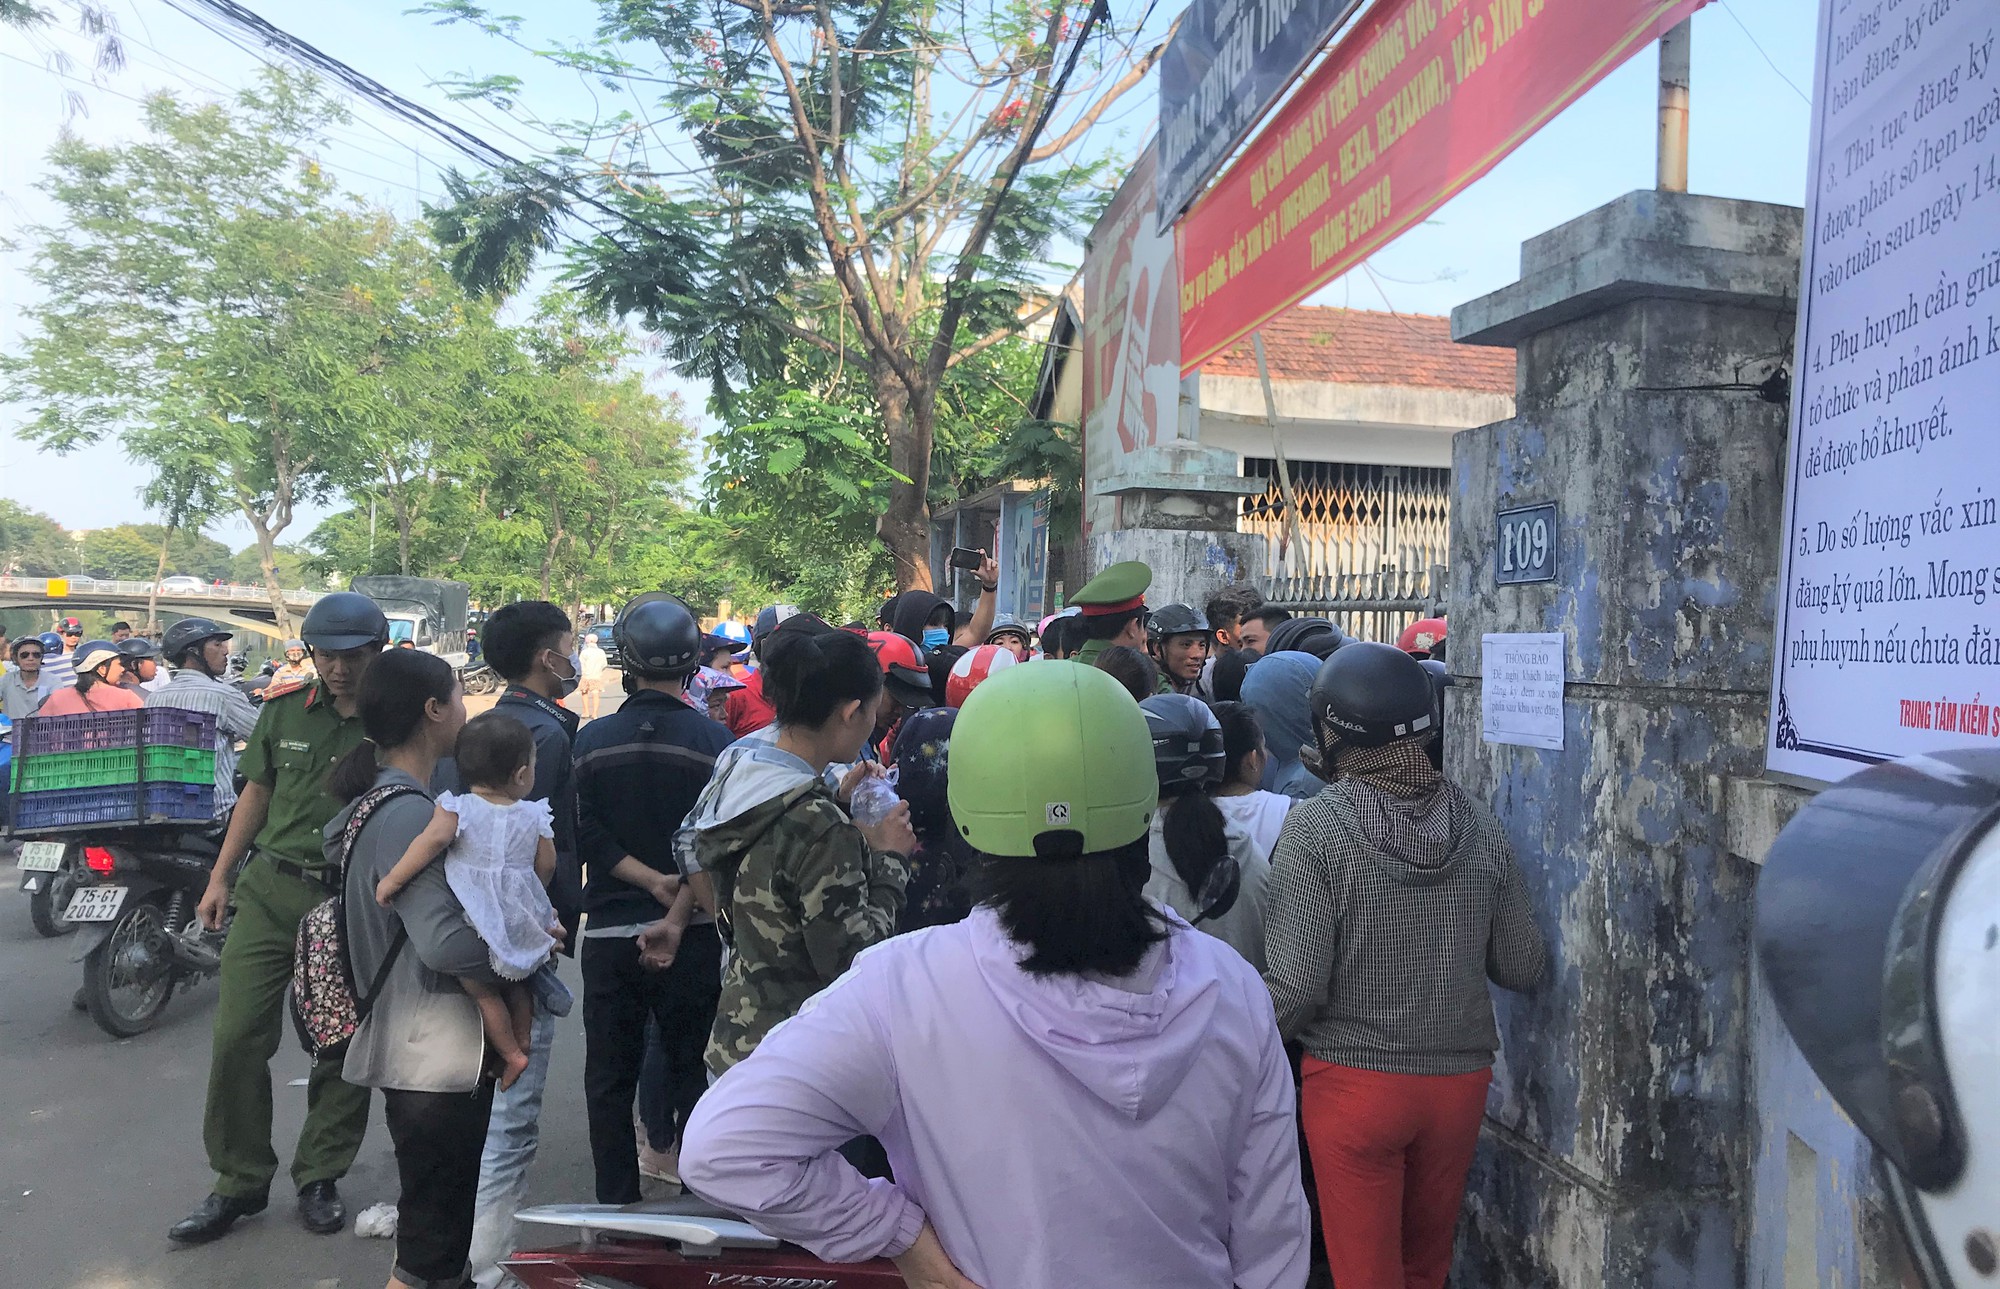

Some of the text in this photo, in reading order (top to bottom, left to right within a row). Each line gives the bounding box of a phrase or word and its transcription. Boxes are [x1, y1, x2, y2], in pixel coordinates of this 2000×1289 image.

[1451, 6, 1487, 85] VẮC
[1832, 77, 1859, 115] bản
[1861, 35, 1901, 89] đăng
[1902, 3, 1926, 51] ký
[1826, 28, 1995, 193] 3. Thủ tục đăng ký
[1822, 87, 2000, 245] được phát số hẹn ngà
[1310, 174, 1391, 271] THÁNG 5/2019
[1818, 262, 1843, 297] vào
[1845, 231, 1882, 280] tuần
[1885, 215, 1916, 256] sau
[1917, 184, 1968, 237] ngày
[1813, 344, 1825, 374] 4.
[1828, 329, 1860, 367] Phụ
[1862, 293, 1919, 347] huynh
[1924, 270, 1960, 320] cần
[1809, 384, 1825, 427] tổ
[1825, 380, 1860, 421] chức
[1863, 369, 1882, 405] và
[1886, 344, 1933, 405] phản
[1938, 324, 1980, 375] ánh
[1805, 396, 1953, 479] để được bổ khuyết.
[1502, 518, 1548, 572] 109
[1799, 486, 1997, 557] 5. Do số lượng vắc xin
[1795, 577, 1831, 615] đăng
[1831, 573, 1852, 614] ký
[1853, 568, 1884, 612] quá
[1888, 565, 1921, 602] lớn.
[1926, 559, 1989, 606] Mong
[1790, 629, 1818, 669] phụ
[1819, 628, 1871, 670] huynh
[1872, 622, 1907, 664] nếu
[1910, 626, 1960, 665] chưa
[1900, 699, 1932, 730] TRUNG
[1934, 696, 1958, 732] TÂM
[1959, 692, 1990, 736] KIỂM
[66, 904, 116, 919] 200.27
[80, 889, 118, 903] 75-G1
[706, 1271, 838, 1289] VISION
